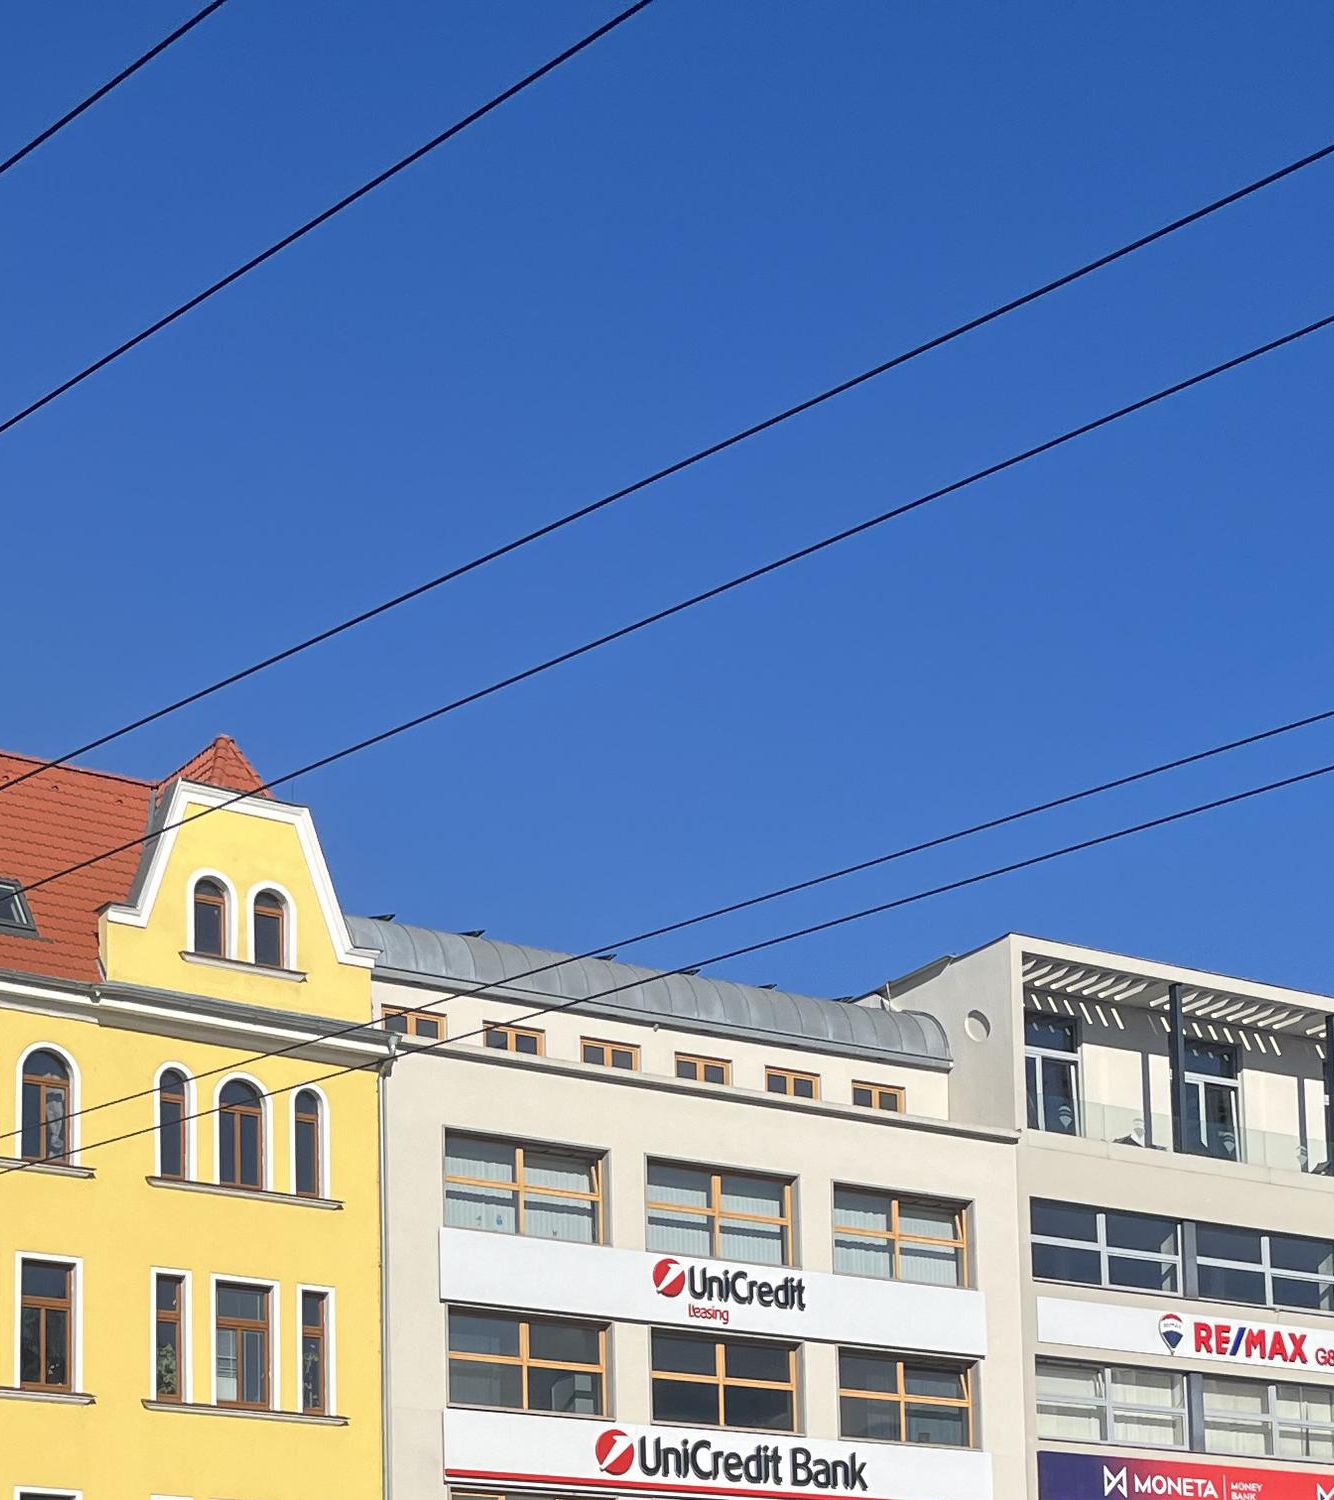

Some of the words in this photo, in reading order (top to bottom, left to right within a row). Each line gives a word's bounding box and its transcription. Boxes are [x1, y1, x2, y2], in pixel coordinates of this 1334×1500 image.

[688, 1265, 807, 1312] UniCredit
[688, 1303, 729, 1325] Leasing
[1193, 1322, 1308, 1365] RE/MAX
[638, 1435, 783, 1486] UniCredit
[789, 1447, 869, 1492] Bank
[1134, 1474, 1219, 1499] MONETA
[1230, 1482, 1264, 1492] MONEY
